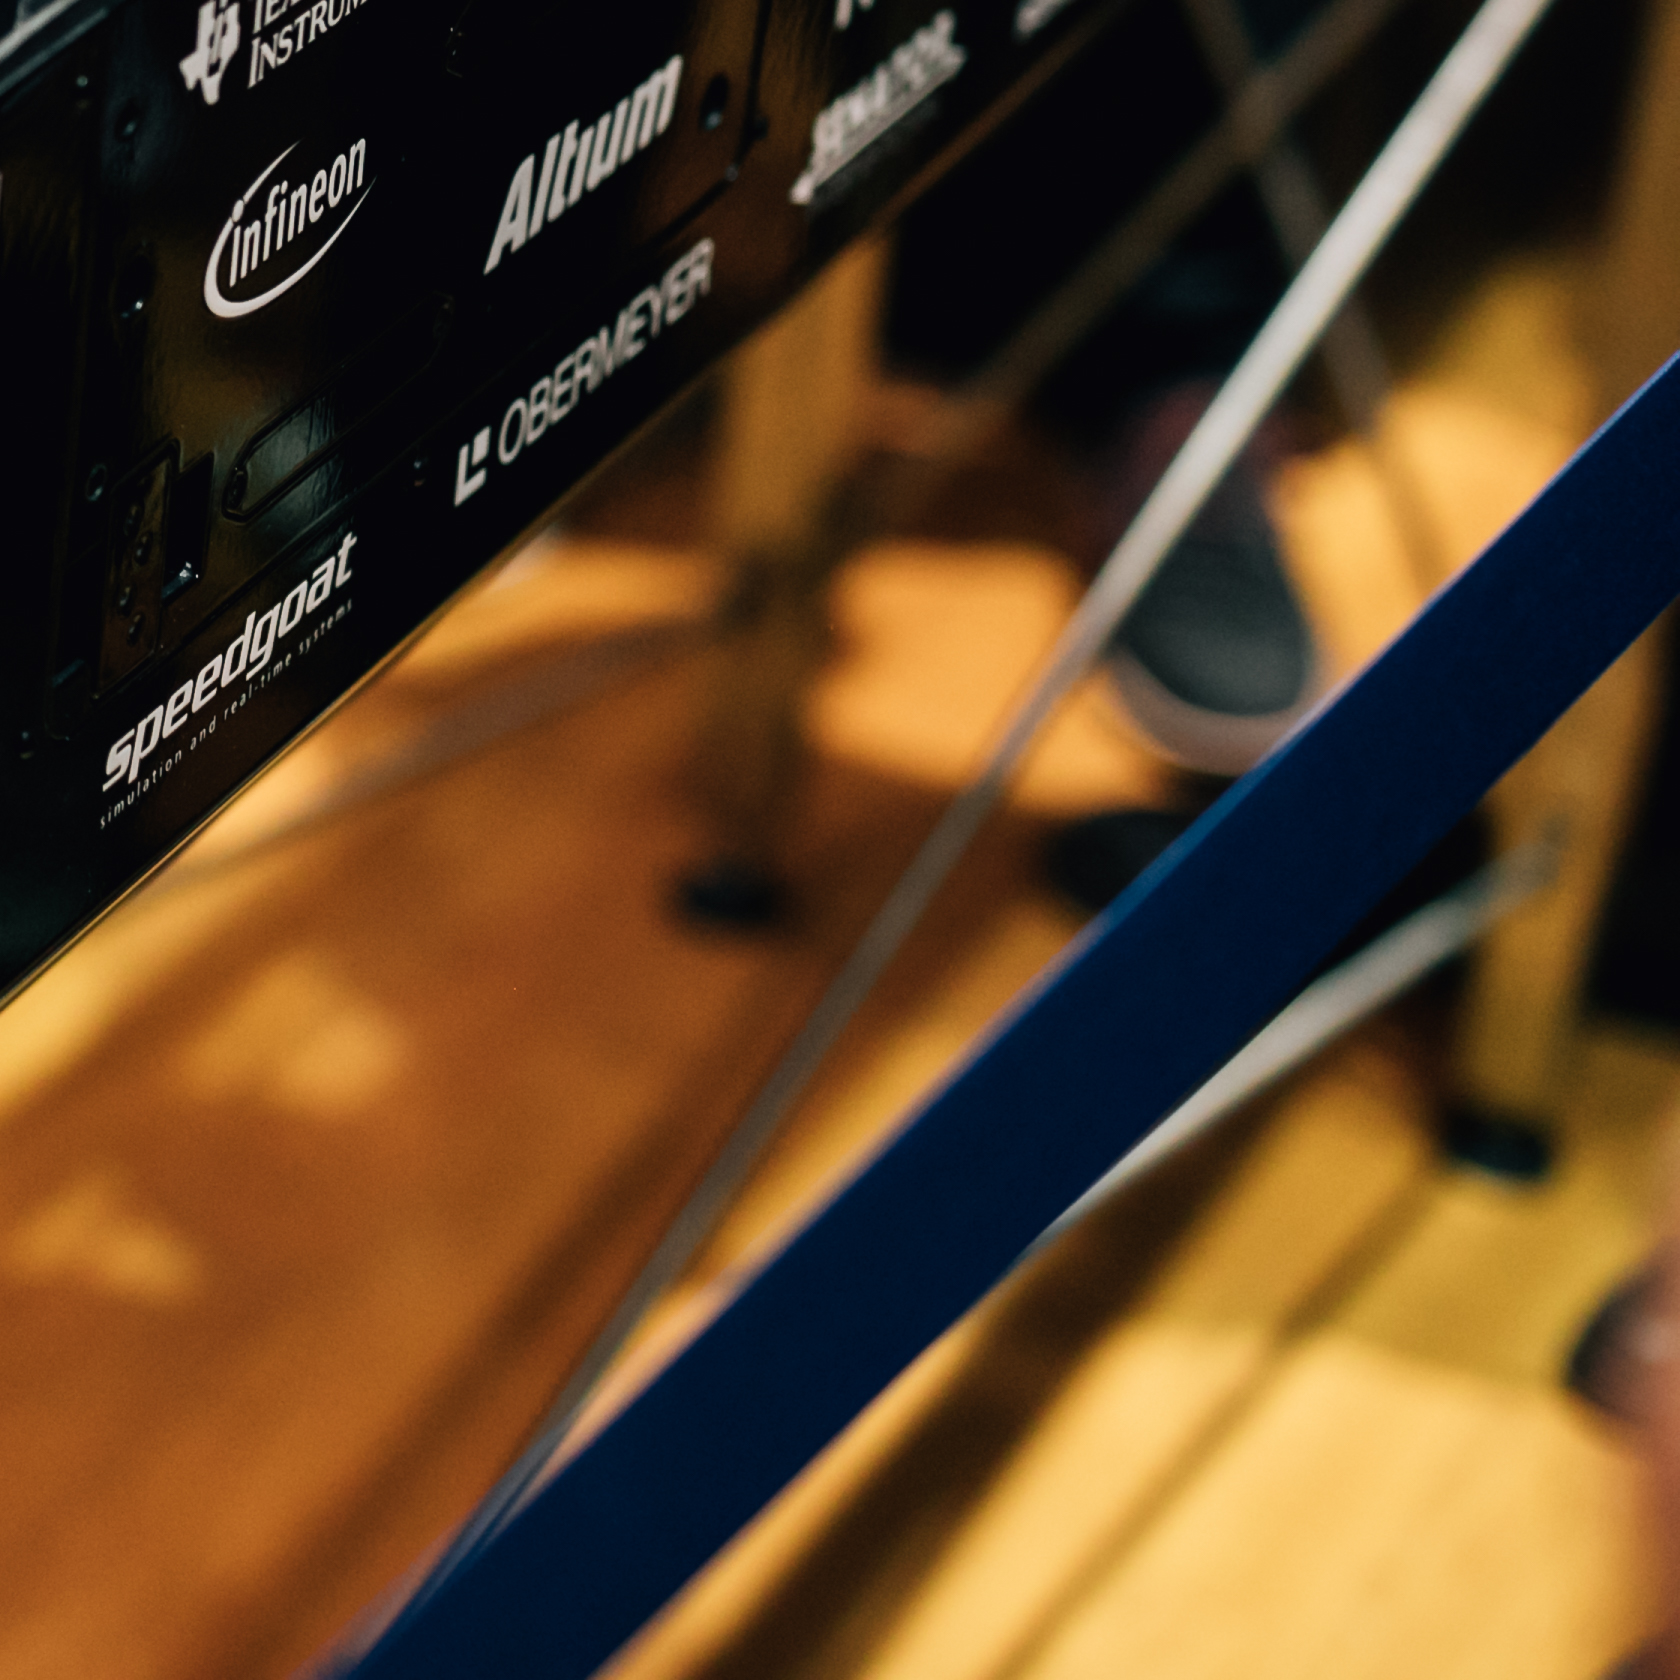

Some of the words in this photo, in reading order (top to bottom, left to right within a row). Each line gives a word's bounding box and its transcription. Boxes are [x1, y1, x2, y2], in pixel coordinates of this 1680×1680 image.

[484, 56, 682, 273] Altium
[498, 238, 714, 464] OBERMEYER
[101, 750, 181, 828] simulation
[189, 715, 217, 752] and
[223, 650, 293, 721] real-time
[298, 598, 353, 656] systems
[103, 533, 357, 791] speedgoat
